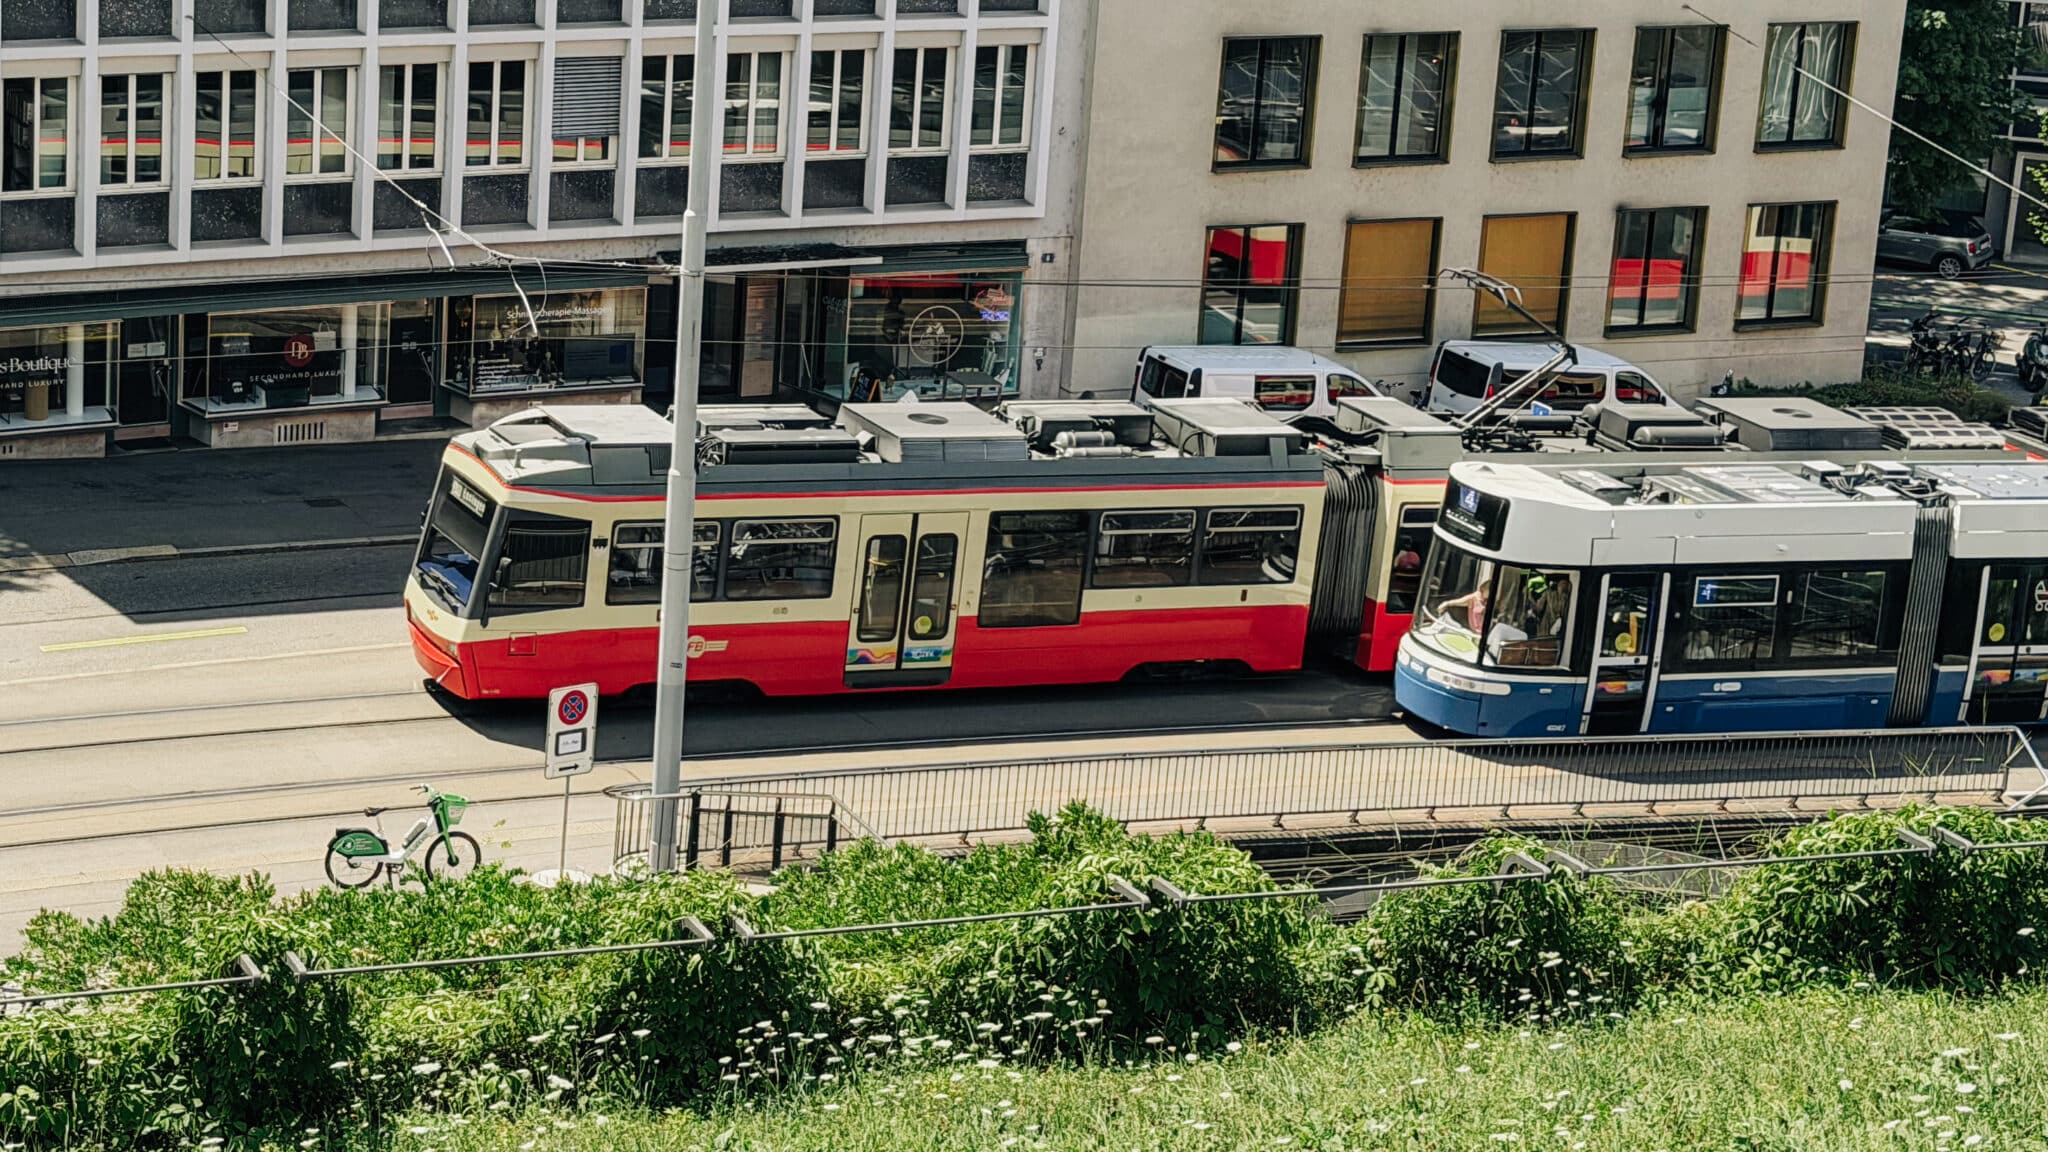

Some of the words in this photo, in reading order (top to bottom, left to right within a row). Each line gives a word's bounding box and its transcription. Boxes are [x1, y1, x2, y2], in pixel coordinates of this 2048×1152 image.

[9, 356, 77, 375] Boutique
[28, 379, 65, 388] LUXURY
[249, 371, 310, 383] SECONDHAND
[1464, 490, 1476, 508] 4
